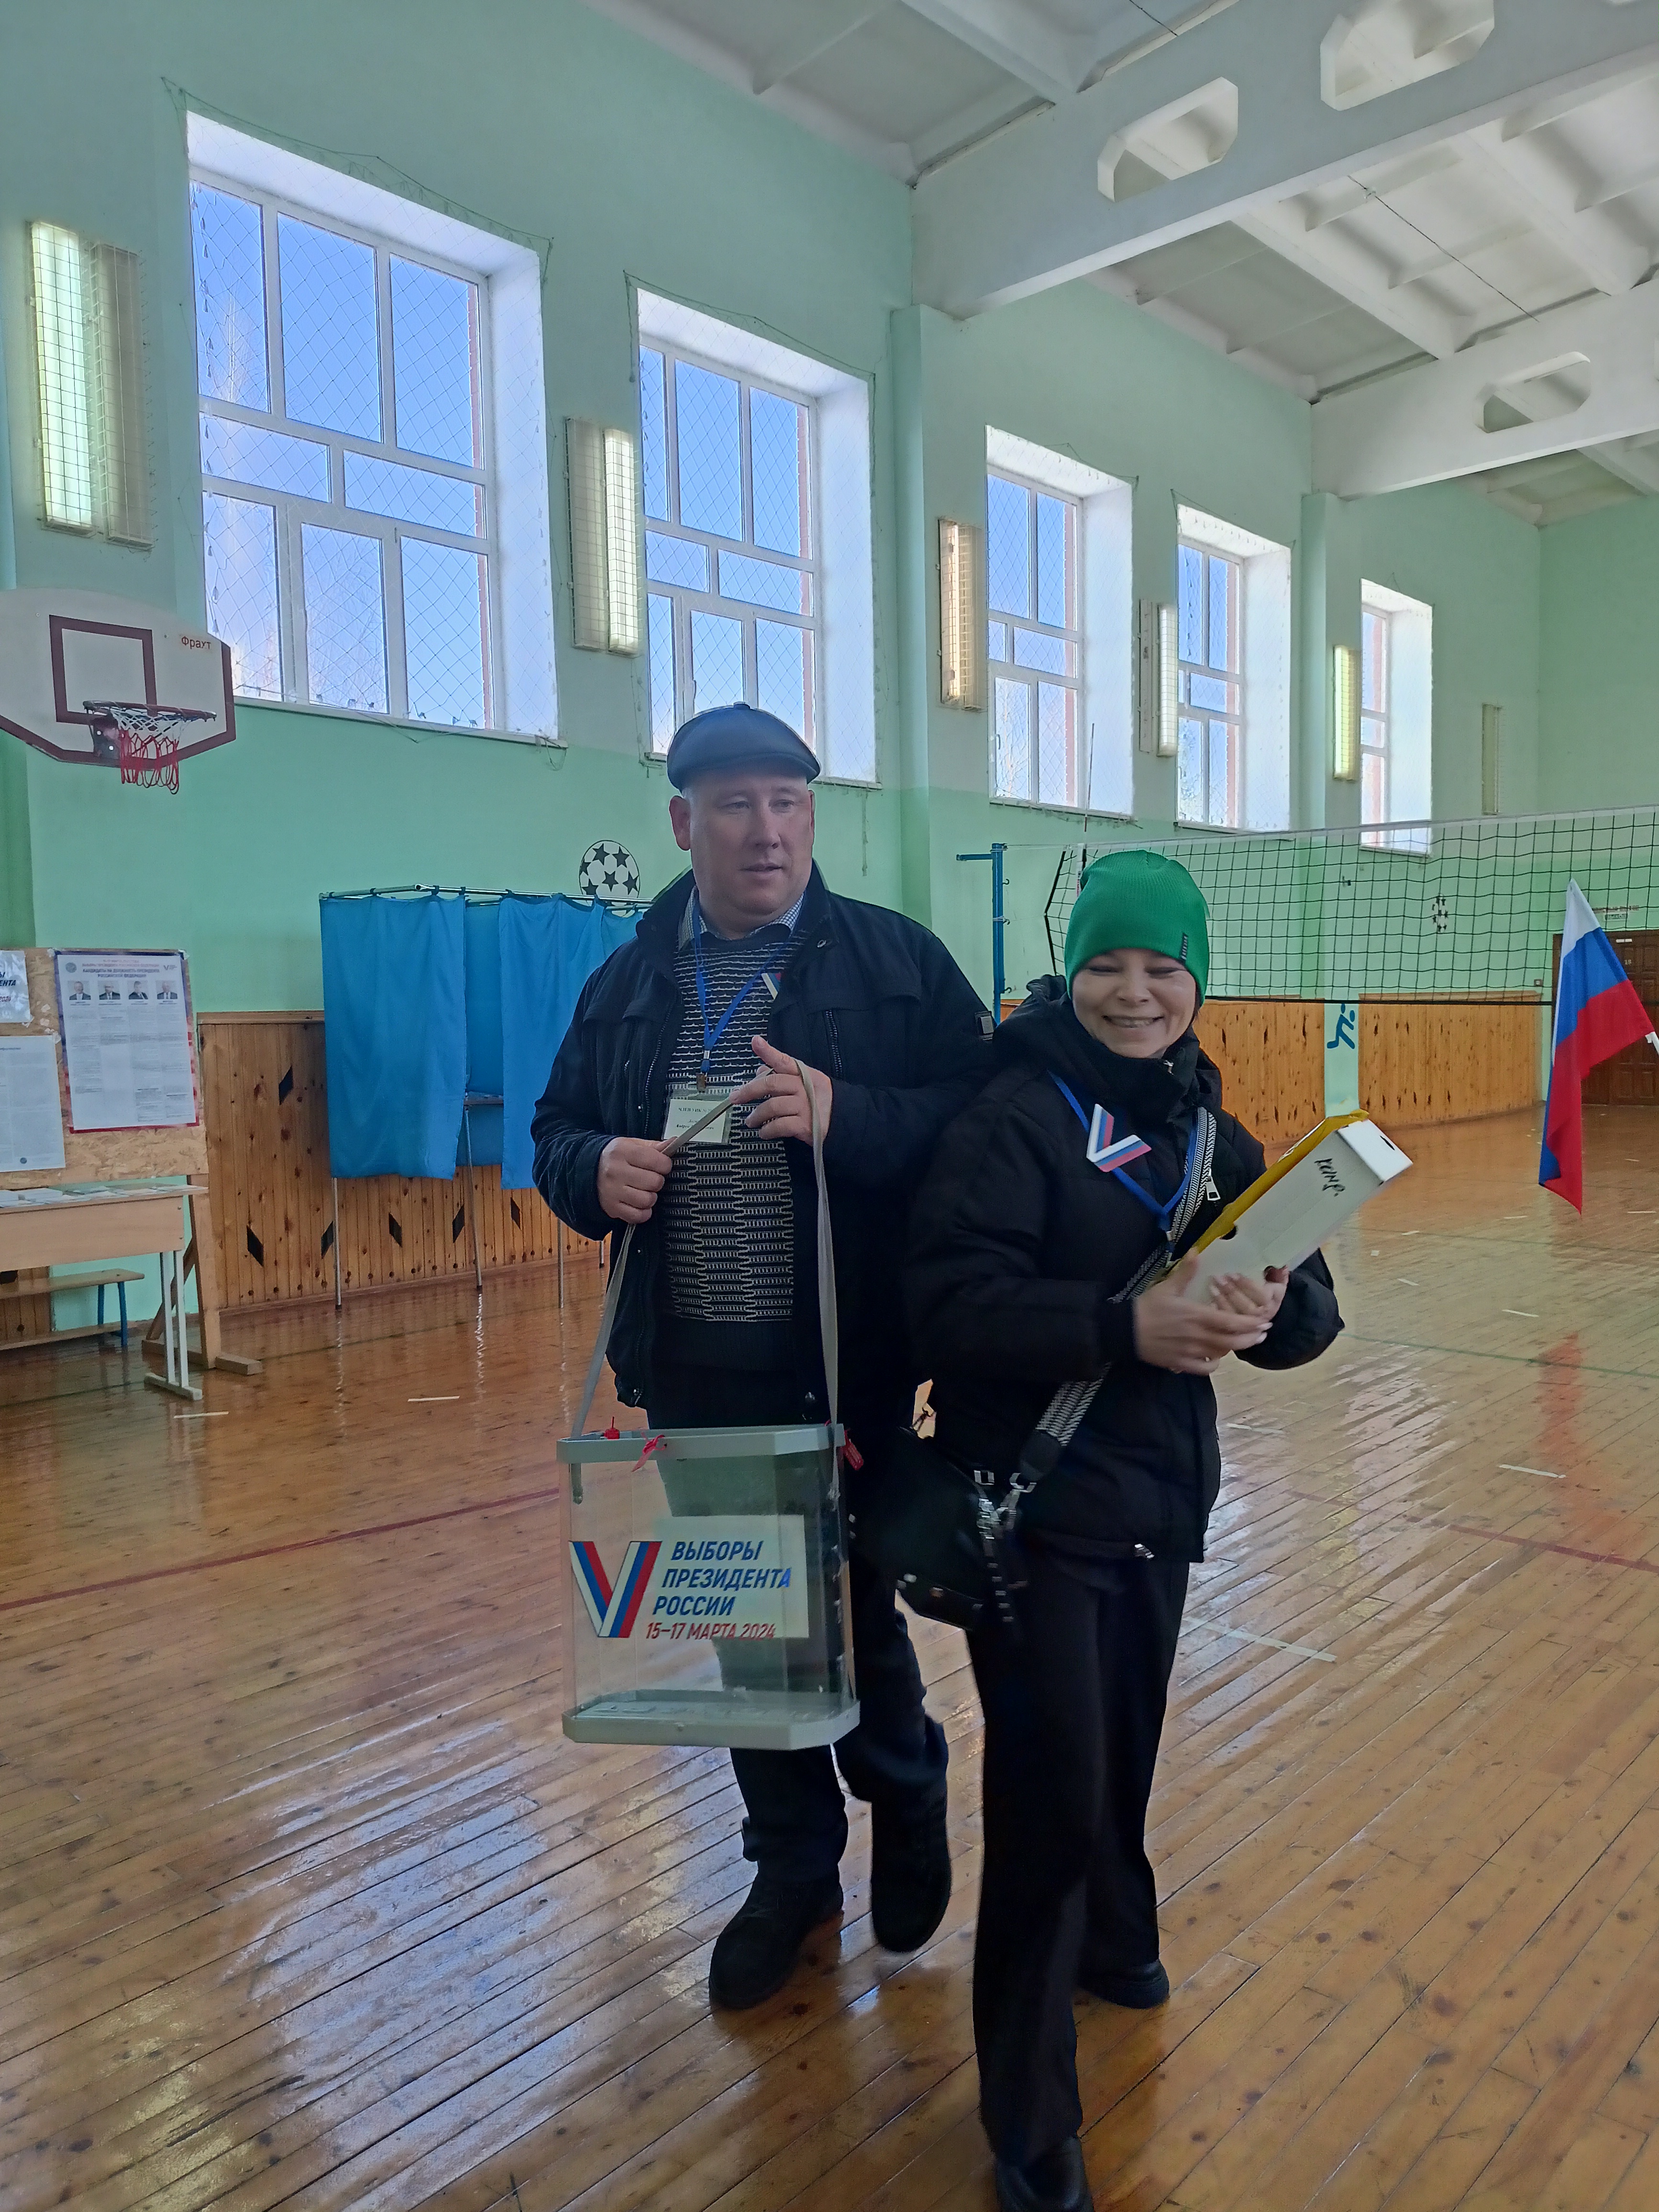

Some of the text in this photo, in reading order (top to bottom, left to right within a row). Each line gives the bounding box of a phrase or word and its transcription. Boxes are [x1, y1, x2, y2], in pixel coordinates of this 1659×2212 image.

[671, 1540, 764, 1561] ВЫБОРЫ
[661, 1567, 792, 1592] ПРЕЗИДЕНТА
[653, 1595, 736, 1616] РОССИИ
[686, 1623, 737, 1640] МАРТА
[739, 1623, 776, 1641] 2024
